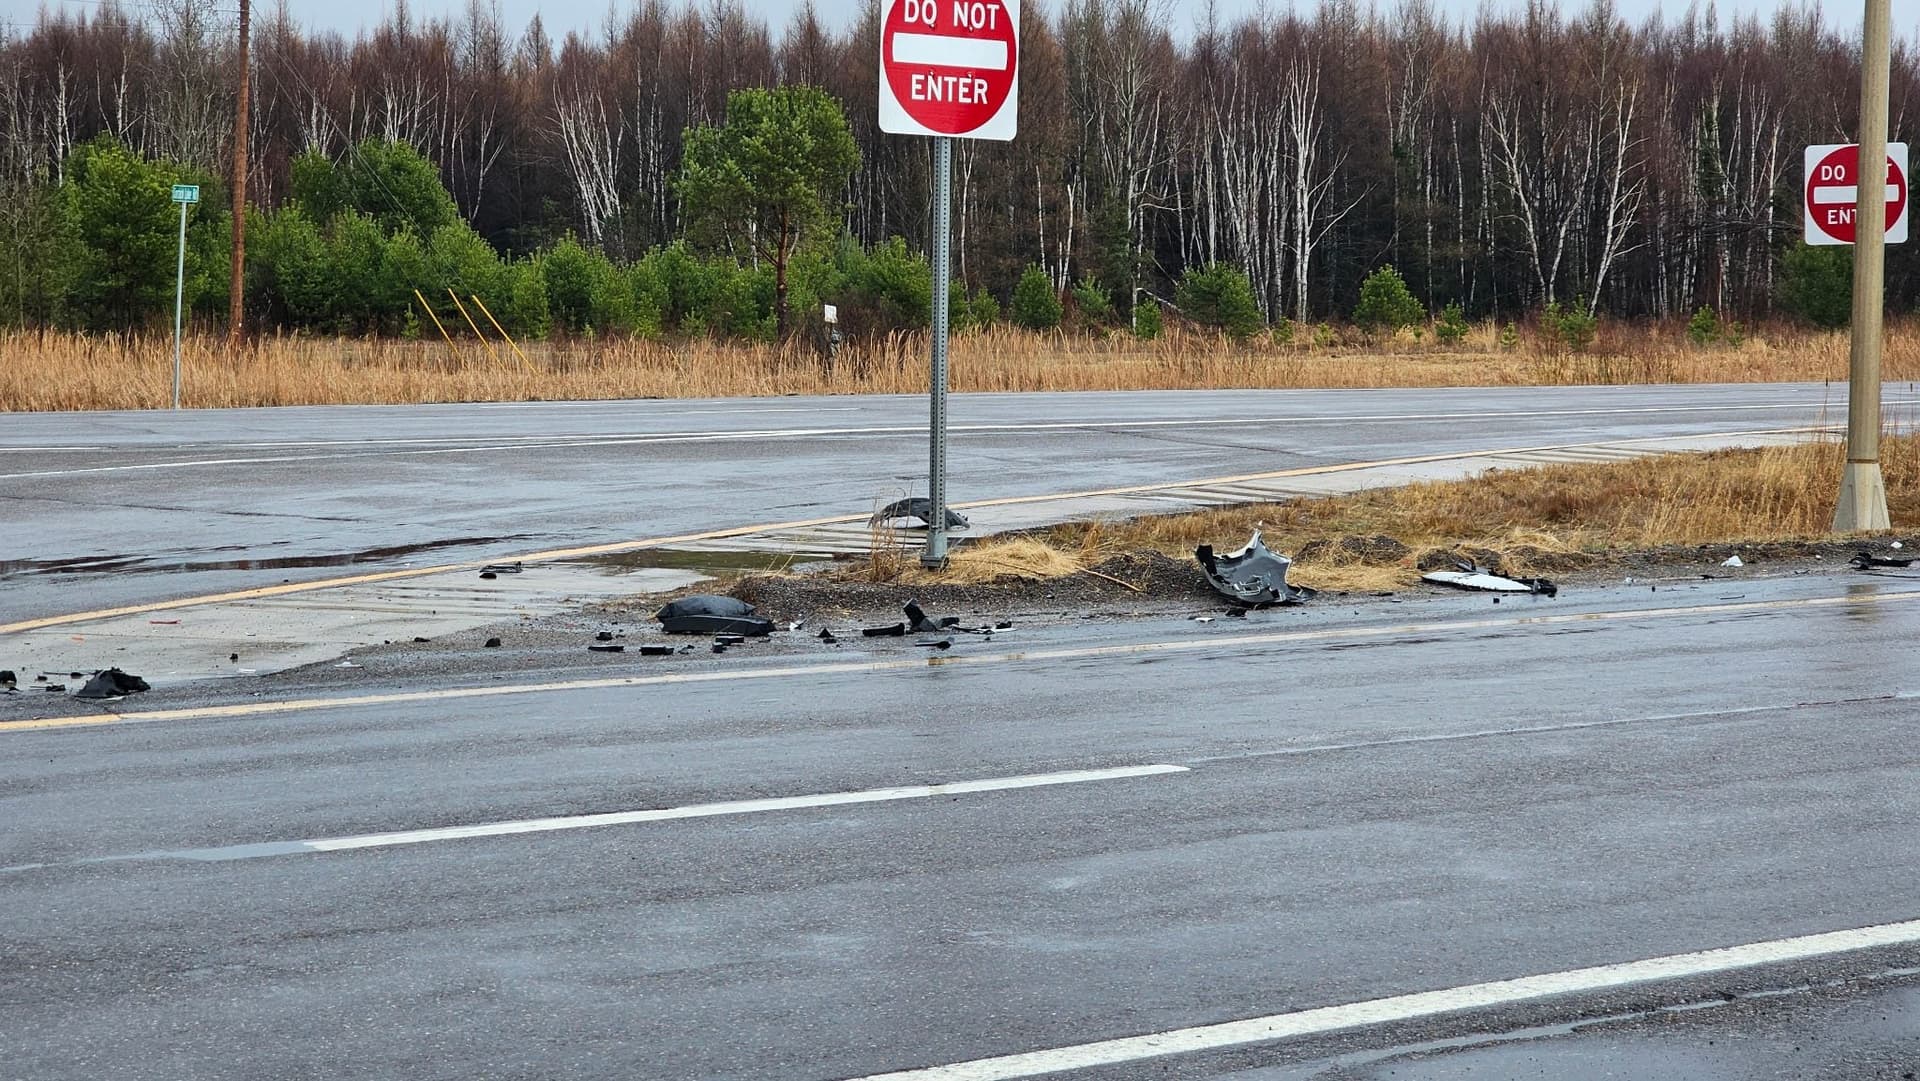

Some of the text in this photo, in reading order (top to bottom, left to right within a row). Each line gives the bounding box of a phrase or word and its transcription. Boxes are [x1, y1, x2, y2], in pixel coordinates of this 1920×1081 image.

[904, 0, 1000, 30] DO NOT
[911, 73, 988, 105] ENTER
[1821, 164, 1846, 182] DO
[1827, 209, 1857, 225] ENT
